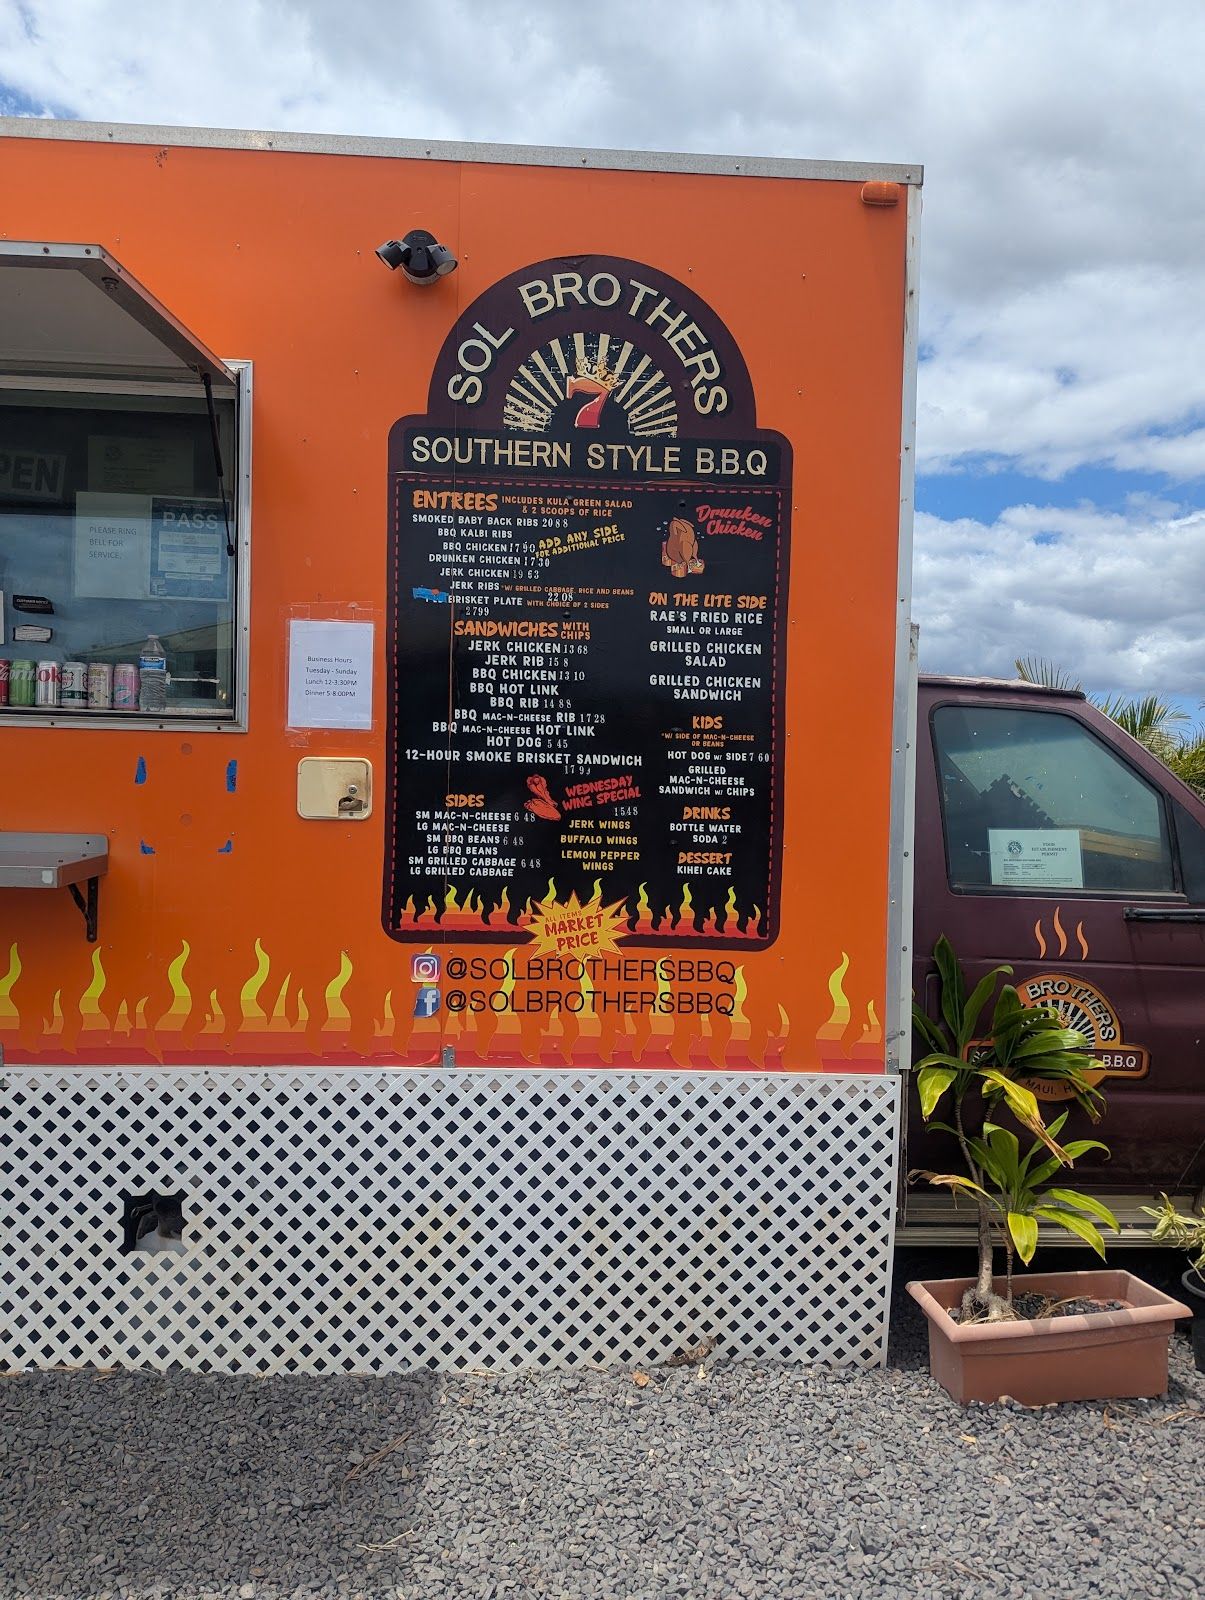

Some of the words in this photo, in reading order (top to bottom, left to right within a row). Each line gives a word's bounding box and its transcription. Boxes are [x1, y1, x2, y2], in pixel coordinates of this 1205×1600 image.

[447, 322, 515, 404] SOL
[518, 272, 728, 415] BROTHERS
[411, 437, 572, 468] SOUTHERN
[587, 443, 681, 473] STYLE
[695, 449, 768, 476] B.B.Q
[412, 490, 498, 511] ENTREES
[502, 496, 543, 505] INCLUDES
[573, 498, 602, 507] GREEN
[605, 499, 632, 508] SALAD
[541, 507, 576, 515] SCOOPS
[593, 508, 612, 517] RICE
[696, 504, 772, 528] Drunken
[162, 512, 218, 531] PASS
[412, 514, 453, 523] SMOKED
[458, 516, 483, 525] BABY
[487, 517, 512, 525] BACK
[517, 518, 538, 526] RIBS
[89, 527, 116, 535] PLEASE
[118, 528, 137, 536] RING
[438, 528, 456, 537] BBQ
[461, 529, 488, 537] KALBI
[492, 530, 512, 538] RIBS
[707, 519, 763, 541] Chicken
[108, 539, 123, 547] FOR
[538, 538, 560, 550] ADD
[567, 532, 588, 543] ANY
[594, 524, 618, 536] SIDE
[443, 542, 461, 552] BBQ
[466, 543, 507, 552] CHICKEN
[536, 550, 550, 559] FOR
[552, 540, 599, 555] ADDITIONAL
[602, 534, 625, 544] PRICE
[429, 554, 475, 563] DRUNKEN
[480, 555, 520, 564] CHICKEN
[440, 568, 464, 577] JERK
[468, 569, 509, 578] CHICKEN
[450, 581, 473, 589] JERK
[478, 582, 500, 590] RIBS
[448, 595, 489, 604] BRISKET
[494, 597, 522, 605] PLATE
[649, 592, 667, 606] ON
[673, 593, 698, 607] THE
[704, 594, 732, 608] LITE
[737, 596, 767, 609] SIDE
[650, 610, 686, 621] RAE'S
[693, 612, 728, 623] FRIED
[735, 613, 763, 624] RICE
[454, 620, 558, 637] SANDWICHES
[563, 622, 589, 631] WITH
[667, 626, 695, 634] SMALL
[715, 628, 743, 636] LARGE
[560, 631, 591, 640] CHIPS
[468, 640, 500, 651] JERK
[506, 642, 561, 654] CHICKEN
[650, 641, 700, 653] GRILLED
[707, 643, 762, 654] CHICKEN
[485, 655, 517, 665] JERK
[523, 656, 544, 666] RIB
[685, 656, 726, 667] SALAD
[472, 668, 496, 680] BBQ
[502, 669, 556, 681] CHICKEN
[650, 675, 699, 686] GRILLED
[706, 676, 761, 688] CHICKEN
[470, 682, 494, 694] BBQ
[500, 683, 524, 694] HOT
[531, 684, 559, 695] LINK
[674, 689, 741, 701] SANDWICH
[490, 697, 513, 709] BBQ
[520, 698, 539, 708] RIB
[454, 709, 477, 721] BBQ
[483, 713, 551, 722] MAC-N-CHEESE
[556, 712, 575, 723] RIB
[433, 722, 457, 733] BBQ
[462, 725, 531, 735] MAC-N-CHEESE
[536, 724, 561, 735] HOT
[567, 726, 595, 736] LINK
[692, 716, 722, 730] KIDS
[487, 736, 511, 747] HOT
[517, 737, 541, 747] DOG
[405, 749, 460, 761] 12-HOUR
[466, 751, 511, 763] SMOKE
[517, 752, 570, 764] BRISKET
[577, 755, 642, 767] SANDWICH
[668, 751, 687, 760] HOT
[691, 752, 710, 760] DOG
[726, 753, 747, 761] SIDE
[688, 766, 726, 774] GRILLED
[565, 776, 633, 797] WEDNESDAY
[670, 776, 744, 785] MAC-N-CHEESE
[659, 786, 710, 795] SANDWICH
[727, 787, 755, 796] CHIPS
[446, 794, 484, 807] SIDES
[562, 796, 593, 811] WING
[597, 786, 641, 805] SPECIAL
[416, 811, 430, 819] SM
[434, 811, 512, 821] MAC-N-CHEESE
[683, 806, 730, 820] DRINKS
[417, 822, 428, 831] LG
[433, 823, 509, 832] MAC-N-CHEESE
[569, 820, 594, 828] JERK
[599, 821, 630, 829] WINGS
[670, 823, 704, 832] BOTTLE
[709, 824, 741, 833] WATER
[427, 834, 440, 843] SM
[445, 835, 463, 844] BBQ
[468, 835, 500, 844] BEANS
[560, 835, 602, 844] BUFFALO
[607, 836, 637, 845] WINGS
[693, 835, 718, 843] SODA
[428, 846, 438, 854] LG
[443, 846, 461, 855] BBQ
[466, 847, 498, 855] BEANS
[562, 850, 596, 859] LEMON
[601, 851, 640, 860] PEPPER
[409, 857, 423, 865] SM
[428, 857, 467, 866] GRILLED
[472, 858, 516, 866] CABBAGE
[678, 852, 732, 864] DESSERT
[410, 867, 420, 875] LG
[425, 867, 465, 876] GRILLED
[470, 868, 514, 877] CABBAGE
[583, 862, 614, 871] WINGS
[677, 866, 703, 874] KIHEI
[707, 866, 732, 875] CAKE
[560, 910, 582, 920] ITEMS
[545, 914, 603, 937] MARKET
[557, 932, 599, 951] PRICE
[446, 958, 735, 985] @SOLBROTHERSBBQ
[445, 989, 735, 1017] @SOLBROTHERSBBQ
[1026, 980, 1116, 1041] BROTHERS
[1103, 1055, 1136, 1068] B.B.Q
